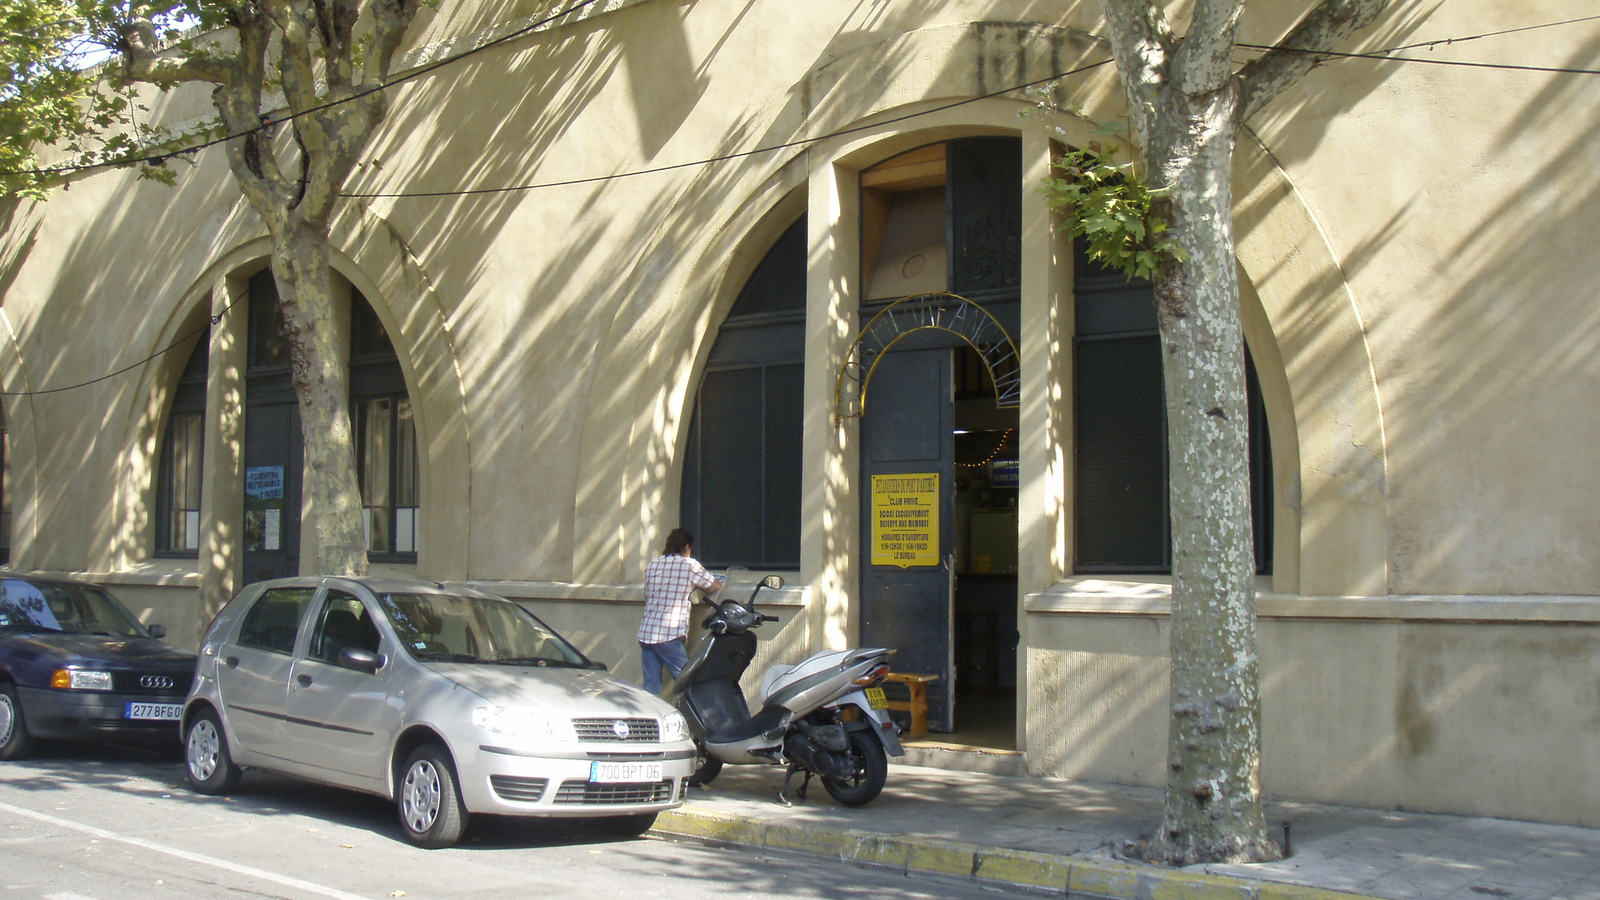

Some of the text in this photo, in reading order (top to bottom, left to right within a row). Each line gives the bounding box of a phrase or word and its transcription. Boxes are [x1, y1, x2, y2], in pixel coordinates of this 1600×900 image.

[906, 478, 916, 493] PORT
[889, 497, 919, 506] CLUB PRIVE
[895, 509, 930, 518] EXCLUSIVEMENT
[907, 519, 929, 527] MEMBRES
[881, 533, 929, 541] HORAIRES D'OUVERTURE
[893, 551, 916, 560] LE BUREAU
[600, 764, 660, 780] 700 BPT 06
